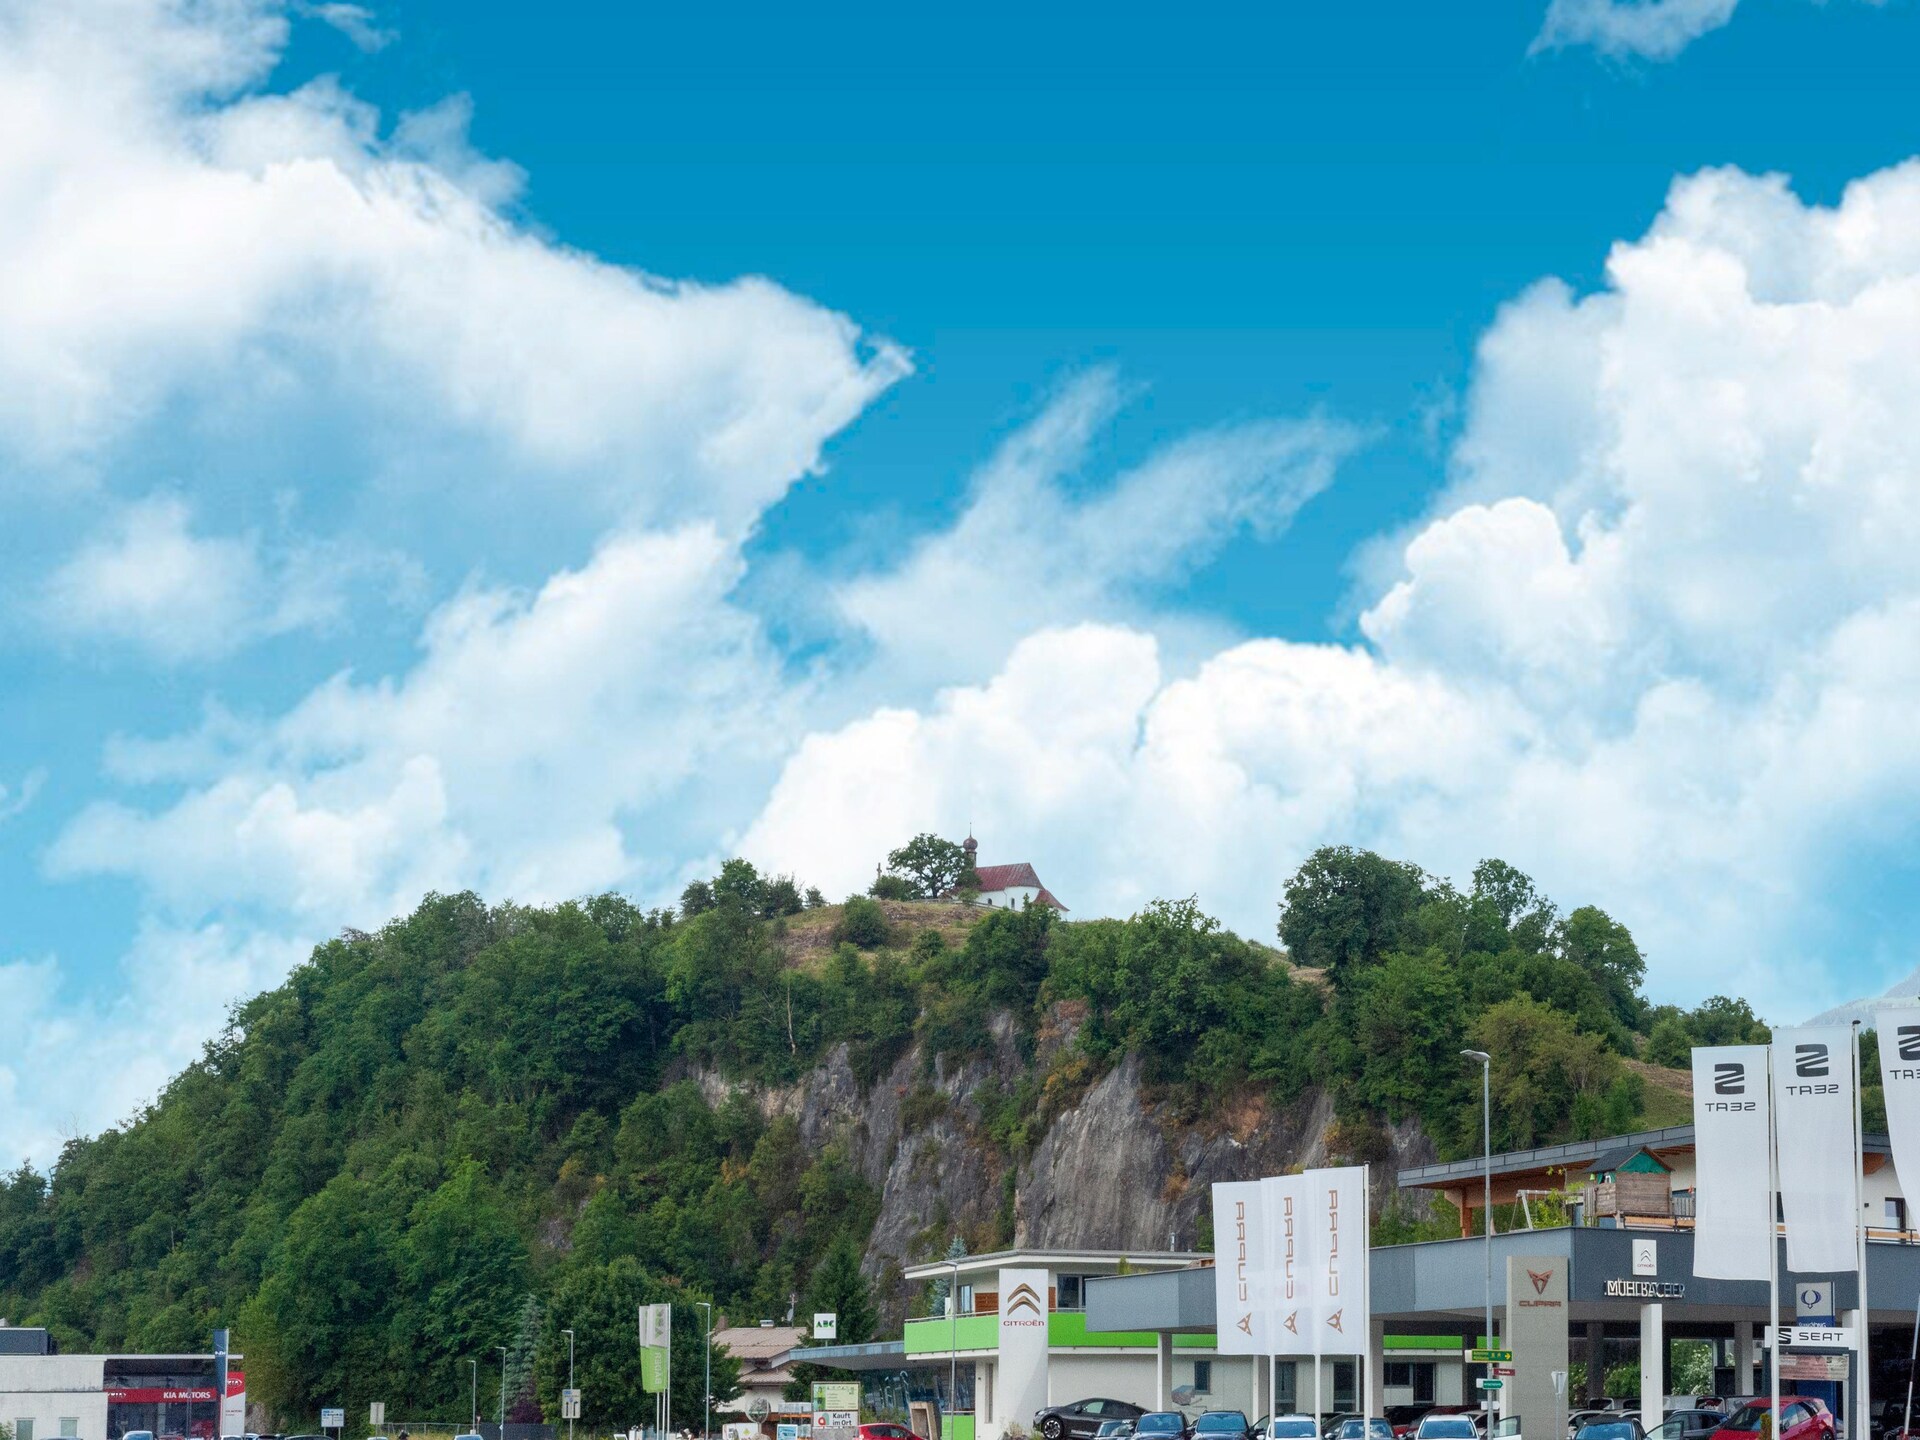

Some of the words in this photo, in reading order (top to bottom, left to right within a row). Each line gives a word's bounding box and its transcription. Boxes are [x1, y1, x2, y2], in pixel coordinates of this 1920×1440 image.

[816, 1320, 835, 1328] ABC
[1798, 1332, 1844, 1341] SEAT
[163, 1391, 177, 1399] KIA
[178, 1391, 211, 1399] MOTORS
